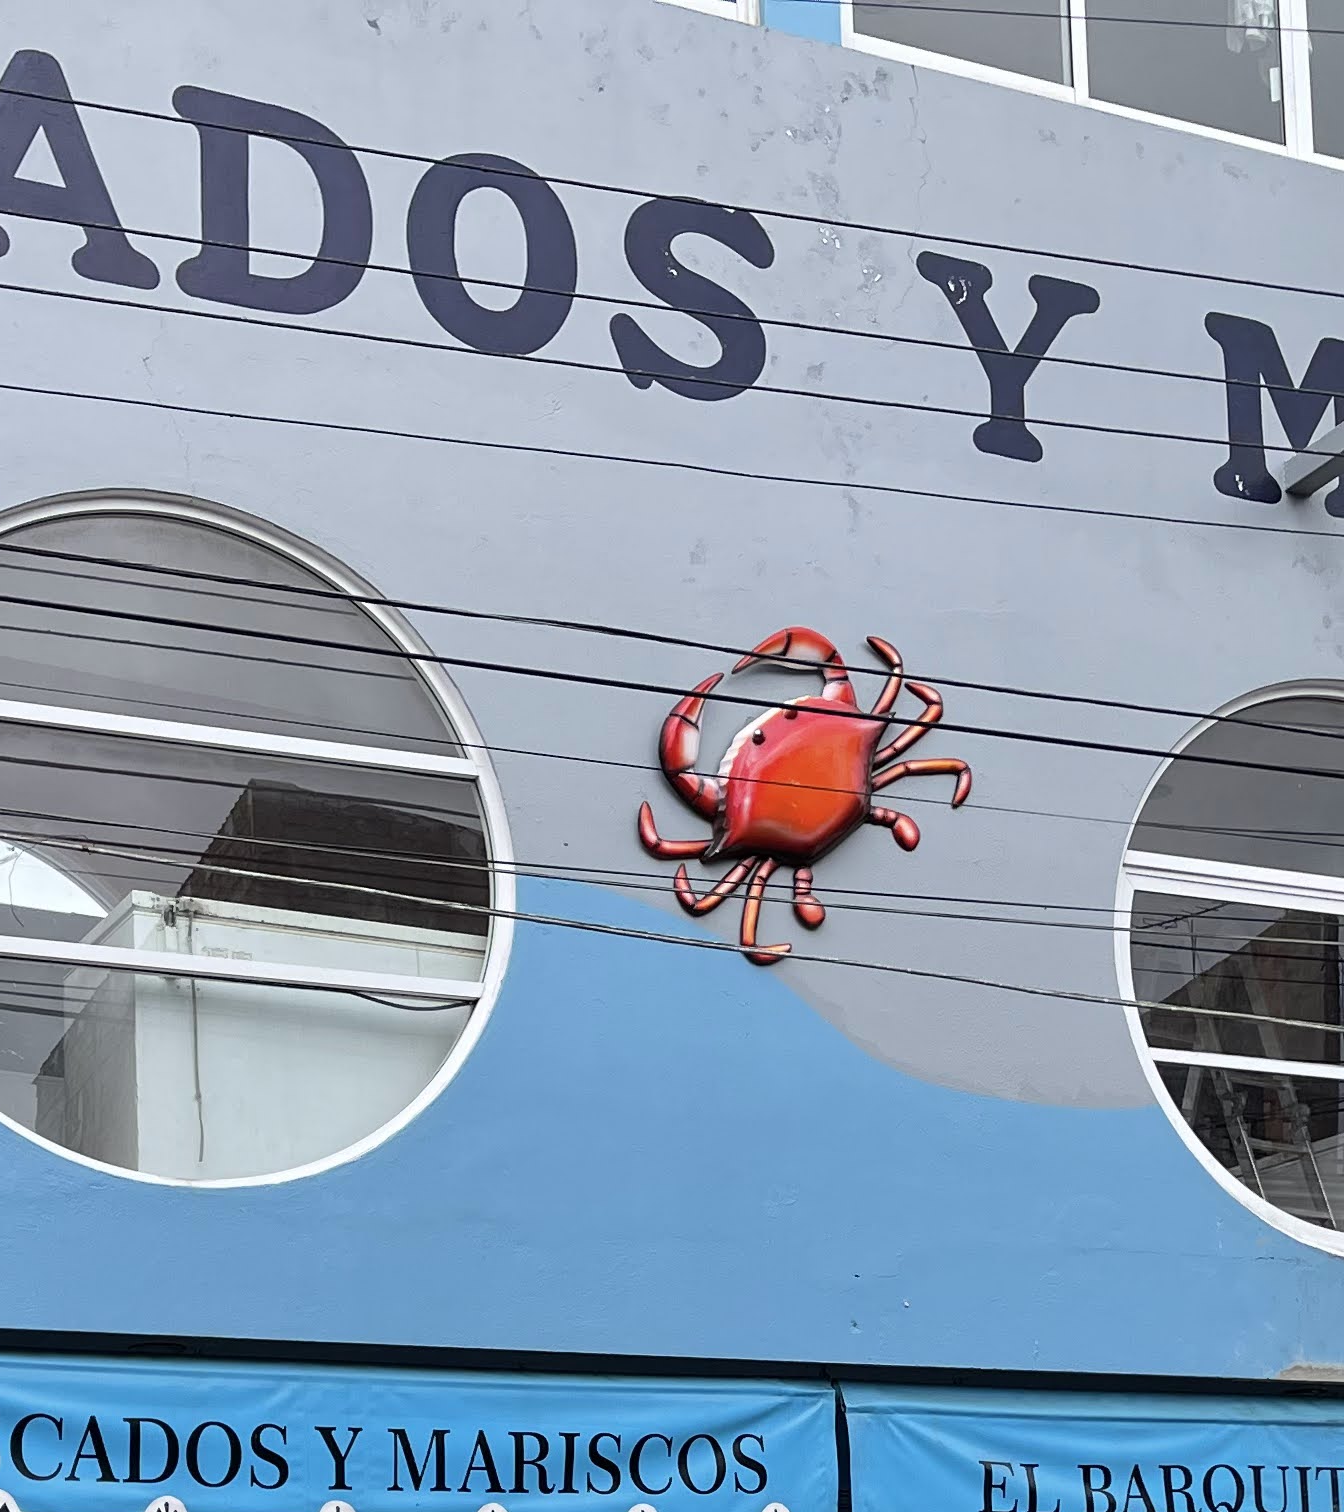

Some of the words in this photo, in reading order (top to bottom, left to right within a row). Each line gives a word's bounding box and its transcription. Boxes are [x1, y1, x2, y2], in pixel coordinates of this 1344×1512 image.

[915, 250, 1101, 463] Y
[313, 1425, 364, 1491] Y
[386, 1428, 769, 1495] MARISCOS
